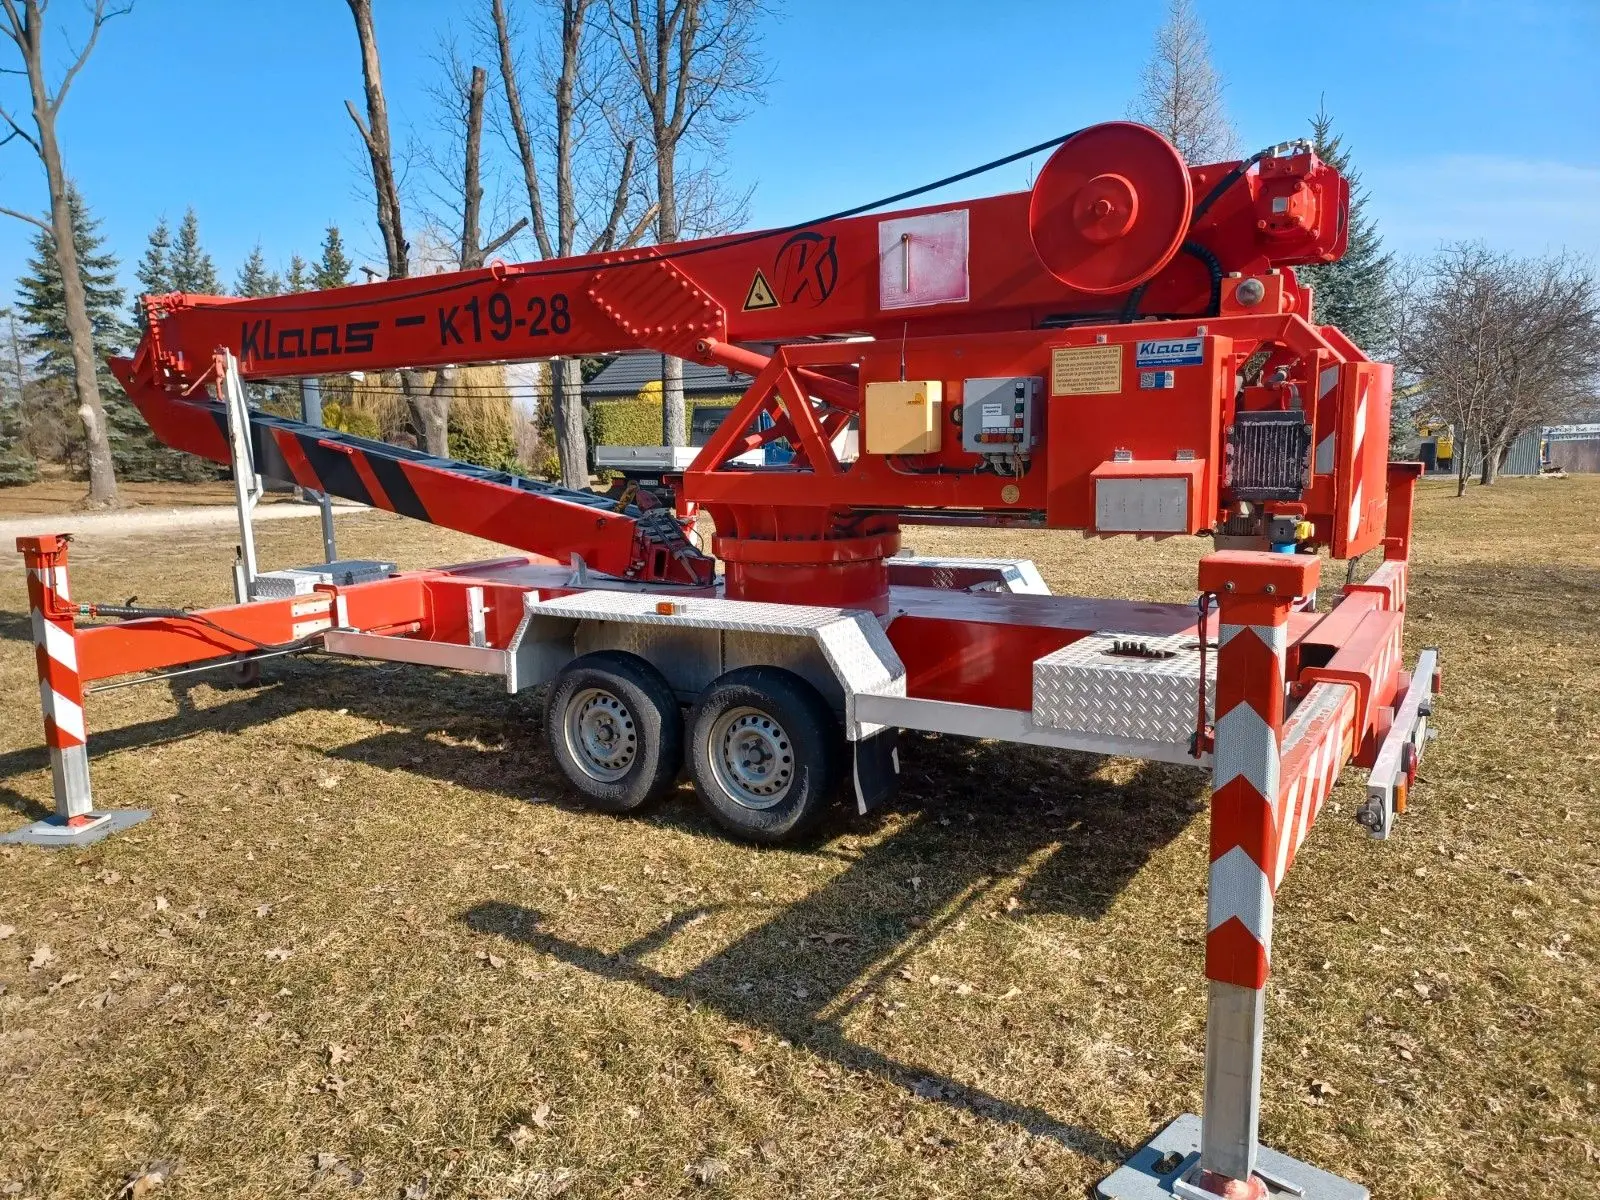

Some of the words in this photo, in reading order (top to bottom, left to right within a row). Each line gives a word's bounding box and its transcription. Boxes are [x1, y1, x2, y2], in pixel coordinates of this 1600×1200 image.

[241, 319, 379, 361] Klaas
[438, 292, 571, 346] K19-28
[1140, 343, 1201, 355] Klaas
